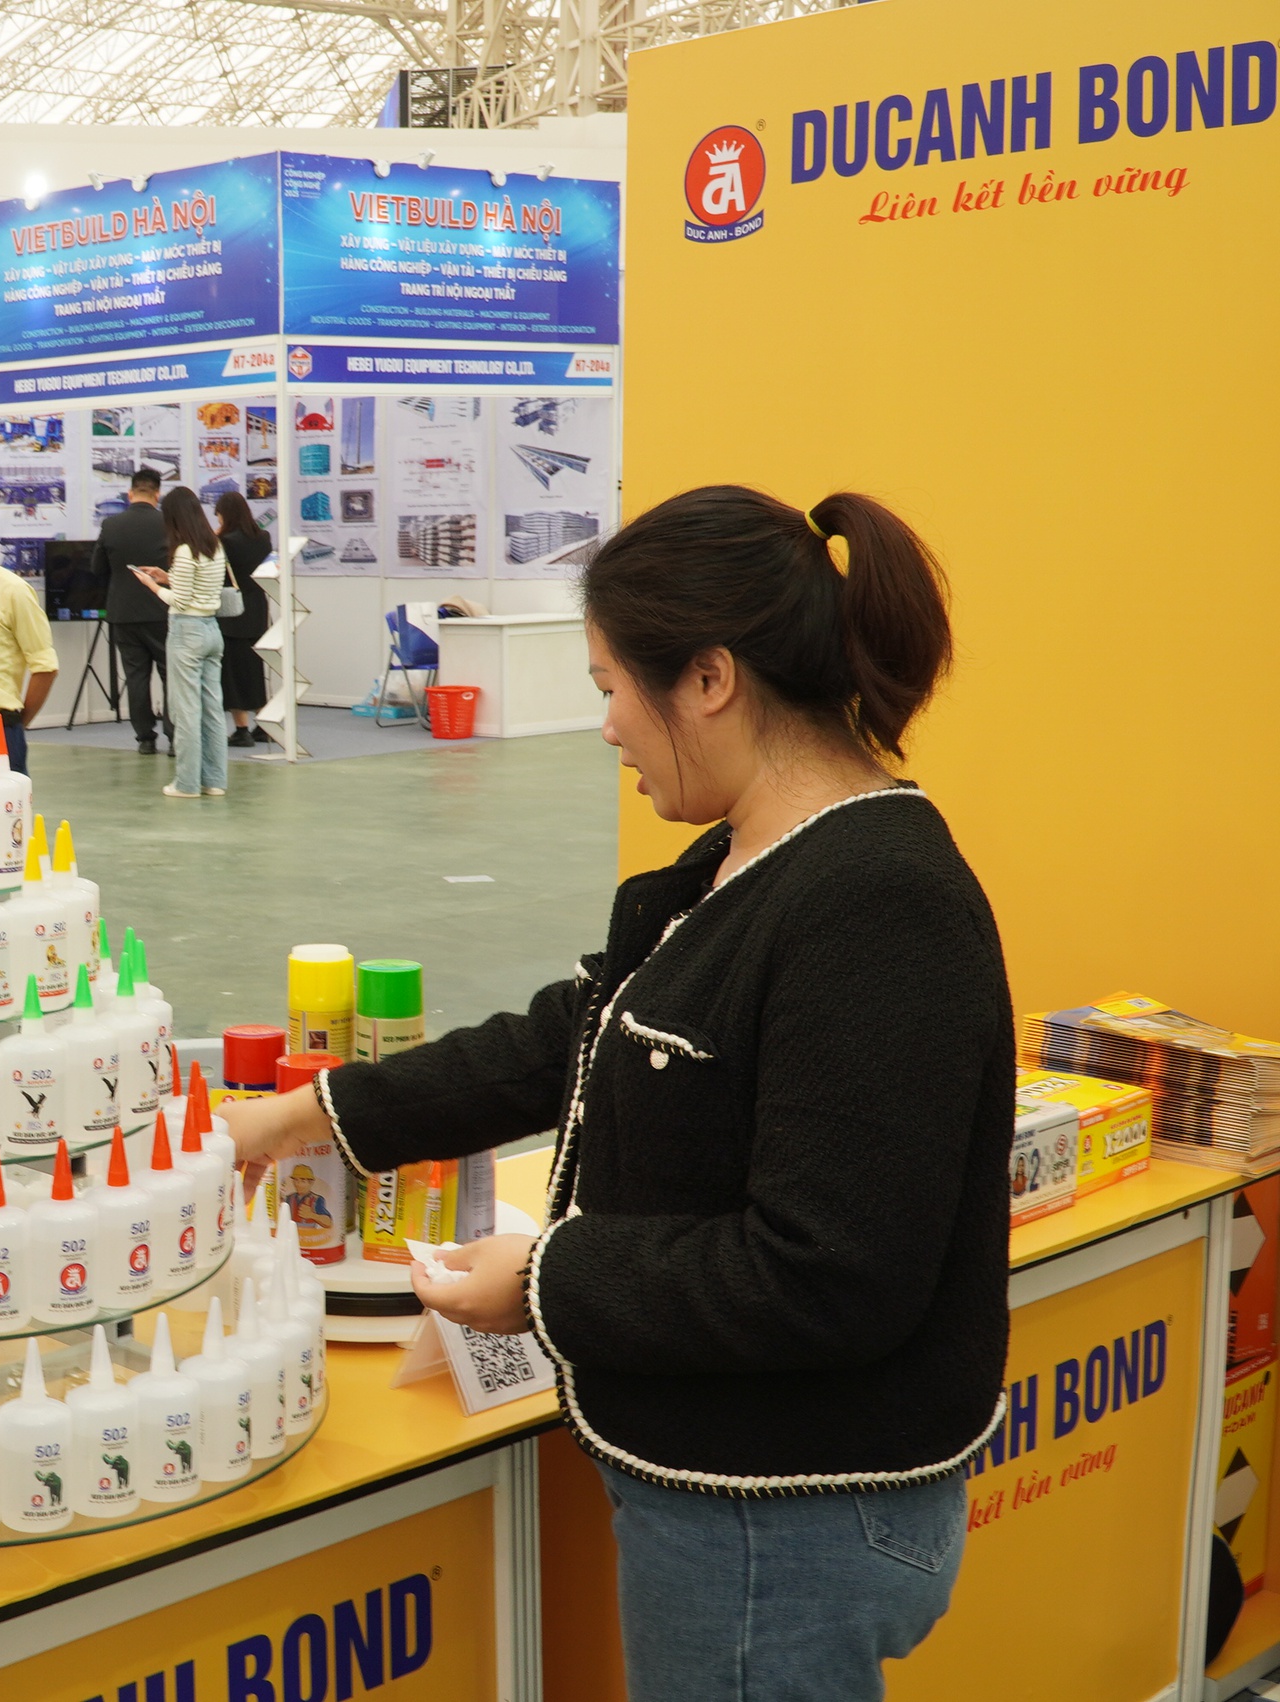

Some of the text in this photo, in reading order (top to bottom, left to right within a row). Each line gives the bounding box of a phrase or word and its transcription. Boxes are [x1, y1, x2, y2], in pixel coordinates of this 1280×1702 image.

[790, 40, 1277, 185] DUCANH BOND
[858, 162, 1192, 227] Liên kết bền vững
[11, 210, 128, 256] VIETBUILD
[132, 196, 168, 238] HÀ
[172, 189, 217, 236] NỘI
[348, 190, 562, 244] VIETBUILD HÀ NỘI
[686, 217, 762, 240] DUC ANH BOND
[340, 233, 361, 248] XÂY
[369, 256, 397, 272] CÔNG
[400, 282, 430, 296] TRANG
[454, 359, 504, 375] TECHNOLOGY
[32, 1069, 53, 1081] 502
[130, 1219, 150, 1235] 502
[61, 1239, 87, 1253] 502
[1053, 1318, 1168, 1441] BOND
[1223, 1381, 1266, 1420] UCANH
[165, 1412, 192, 1428] 502
[102, 1427, 129, 1442] 502
[35, 1443, 62, 1459] 502
[227, 1572, 433, 1702] BOND
